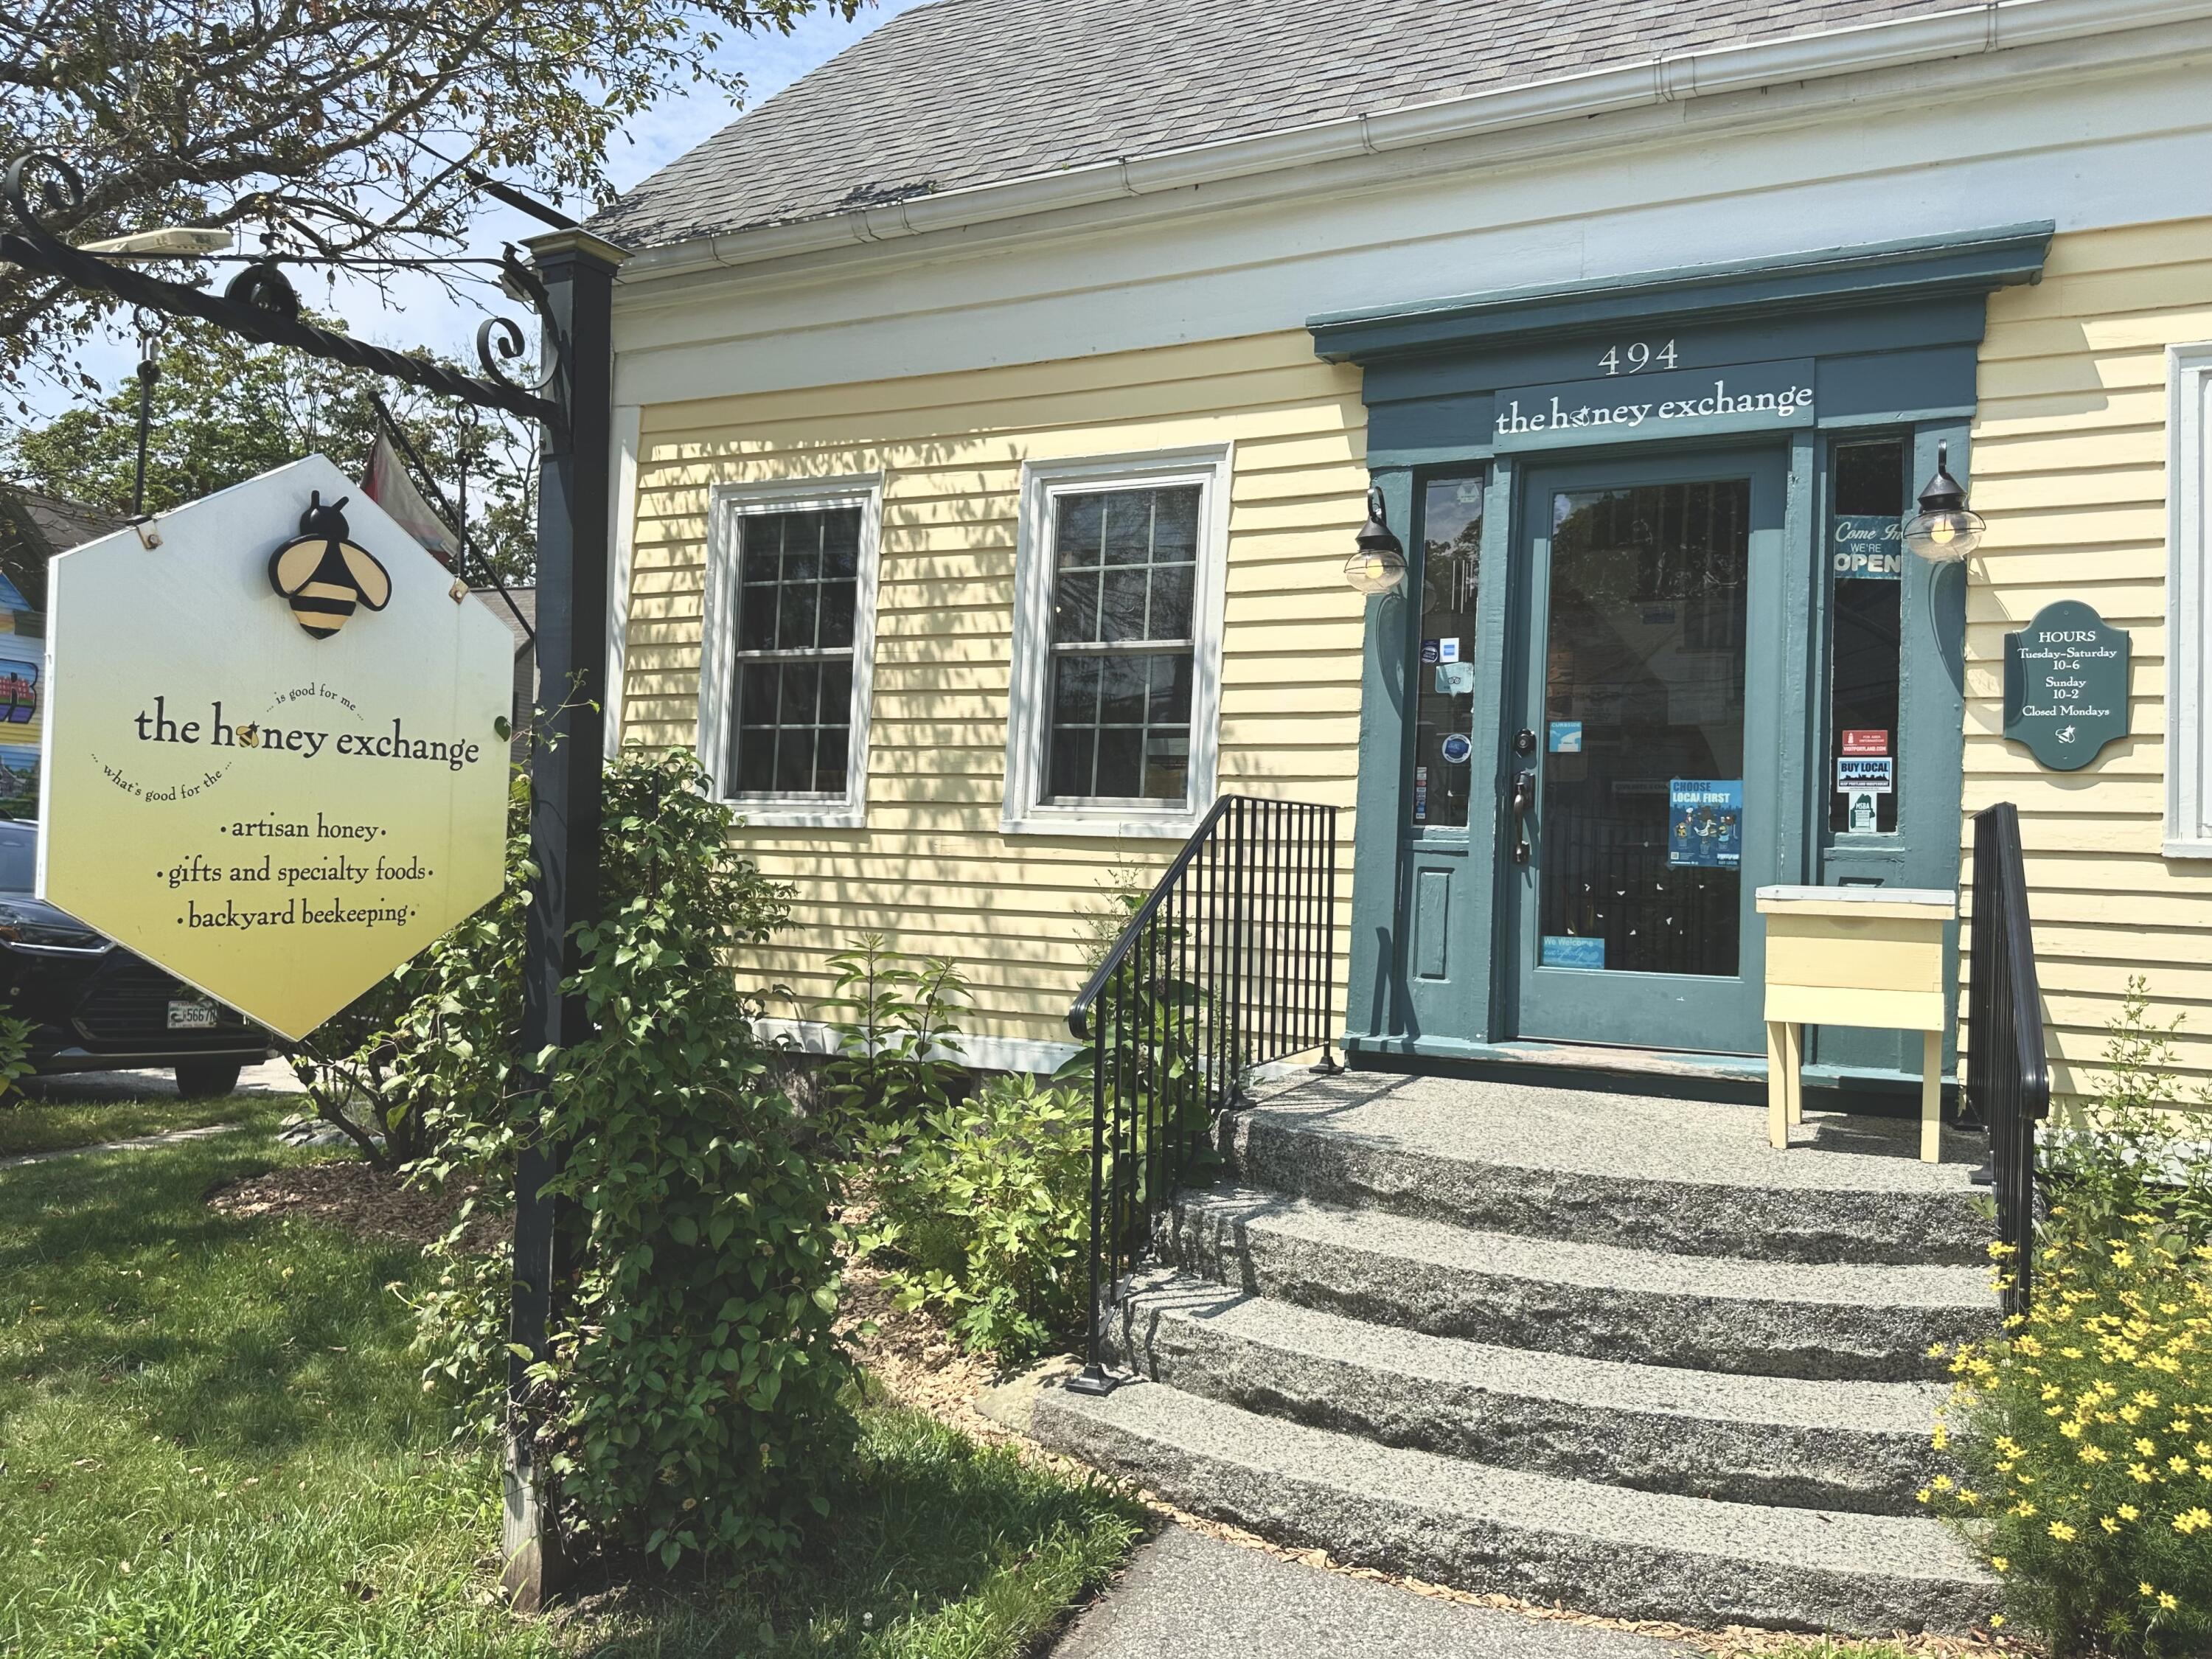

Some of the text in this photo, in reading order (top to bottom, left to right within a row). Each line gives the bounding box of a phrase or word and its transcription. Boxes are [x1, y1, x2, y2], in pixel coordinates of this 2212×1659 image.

[1597, 338, 1678, 375] 494
[1495, 400, 1545, 434] the
[1658, 380, 1812, 417] exchange
[1834, 521, 1902, 542] Come In
[1851, 543, 1882, 552] WE'RE
[1834, 553, 1901, 573] OPEN
[2039, 631, 2096, 642] HOURS
[2053, 660, 2080, 669] 10-6
[2045, 676, 2087, 688] Sunday
[275, 692, 286, 705] is
[289, 682, 315, 701] good
[319, 684, 338, 700] for
[341, 697, 356, 711] me
[2053, 689, 2079, 699] 10-2
[2023, 705, 2110, 717] Closed Mondays
[134, 695, 200, 743] the
[337, 718, 479, 771] exchange
[1841, 762, 1888, 772] BUY LOCAL
[103, 764, 142, 796] what's
[145, 786, 176, 802] good
[180, 784, 201, 799] for
[203, 770, 223, 787] the
[1673, 782, 1711, 791] CHOOSE
[1672, 793, 1731, 803] LOCAL FIRST
[232, 812, 379, 842] artisan honey
[169, 854, 425, 888] gifts and specialty foods
[188, 897, 408, 931] backyard beekeeping
[1544, 937, 1593, 947] We Welcome
